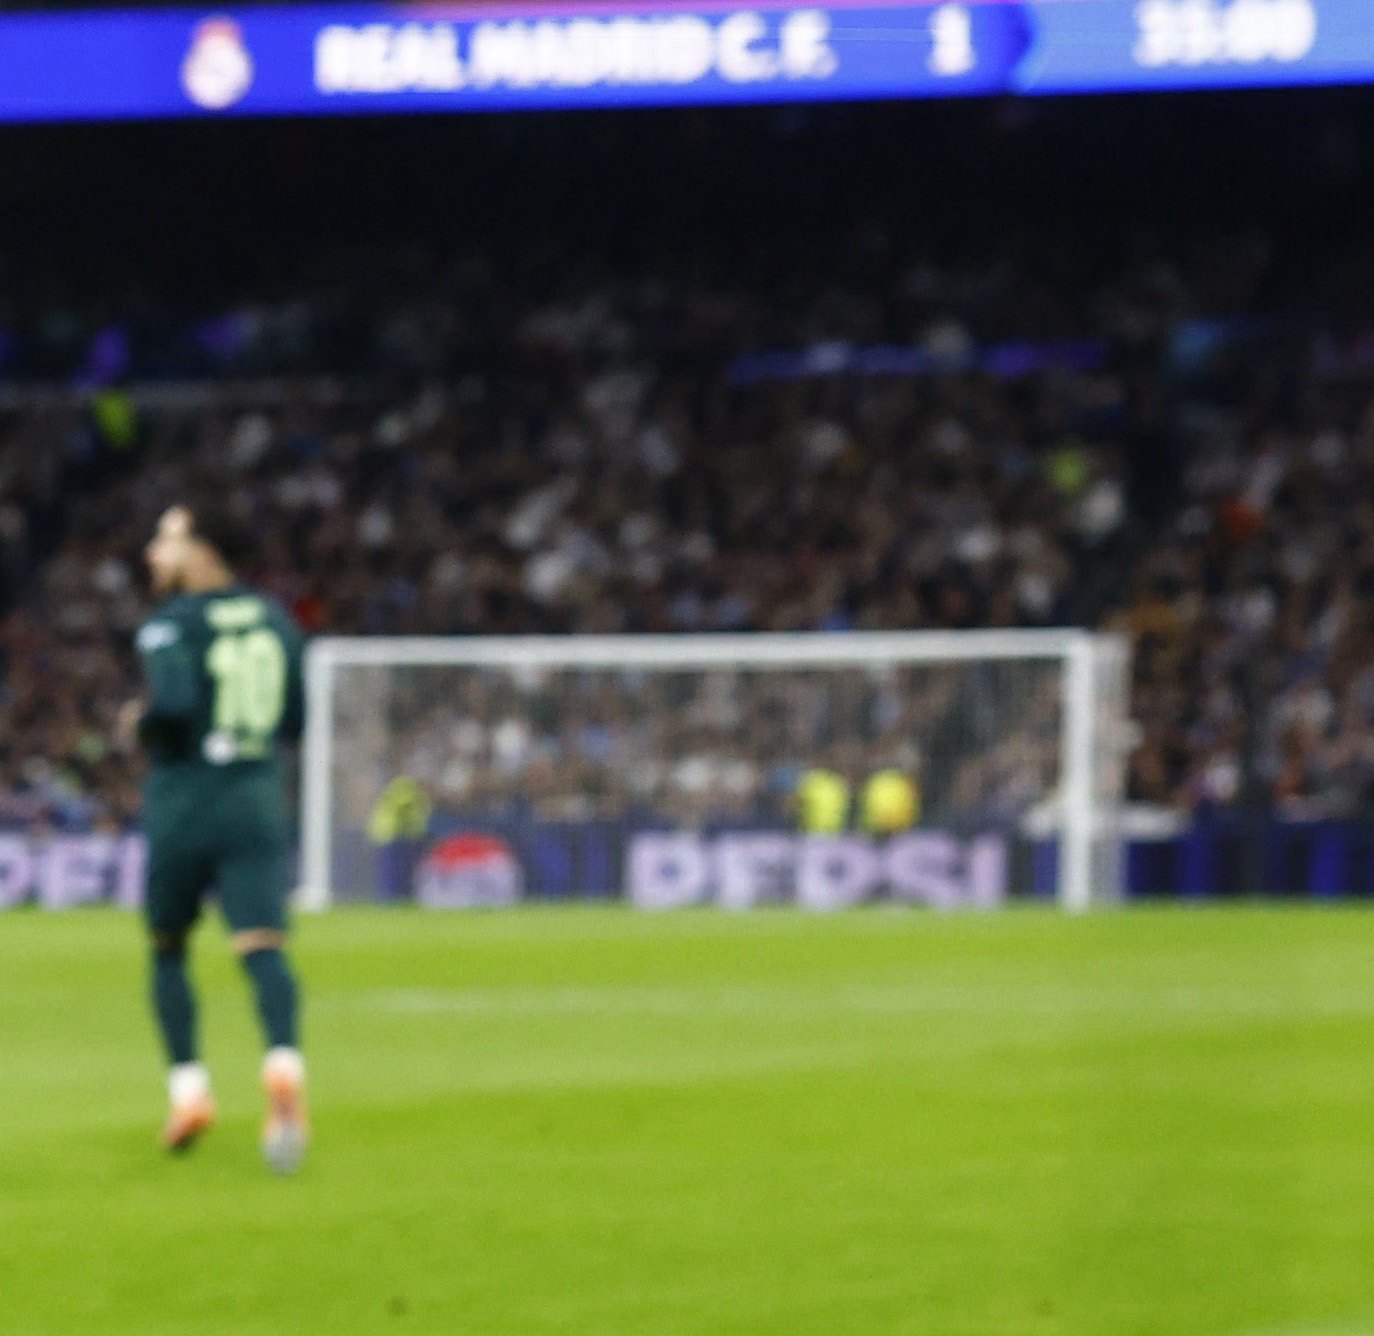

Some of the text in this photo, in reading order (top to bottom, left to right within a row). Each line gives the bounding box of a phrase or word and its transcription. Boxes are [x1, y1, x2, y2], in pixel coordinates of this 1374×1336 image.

[316, 24, 462, 92] REAL
[206, 628, 287, 734] 10
[627, 833, 1008, 910] PEPSI
